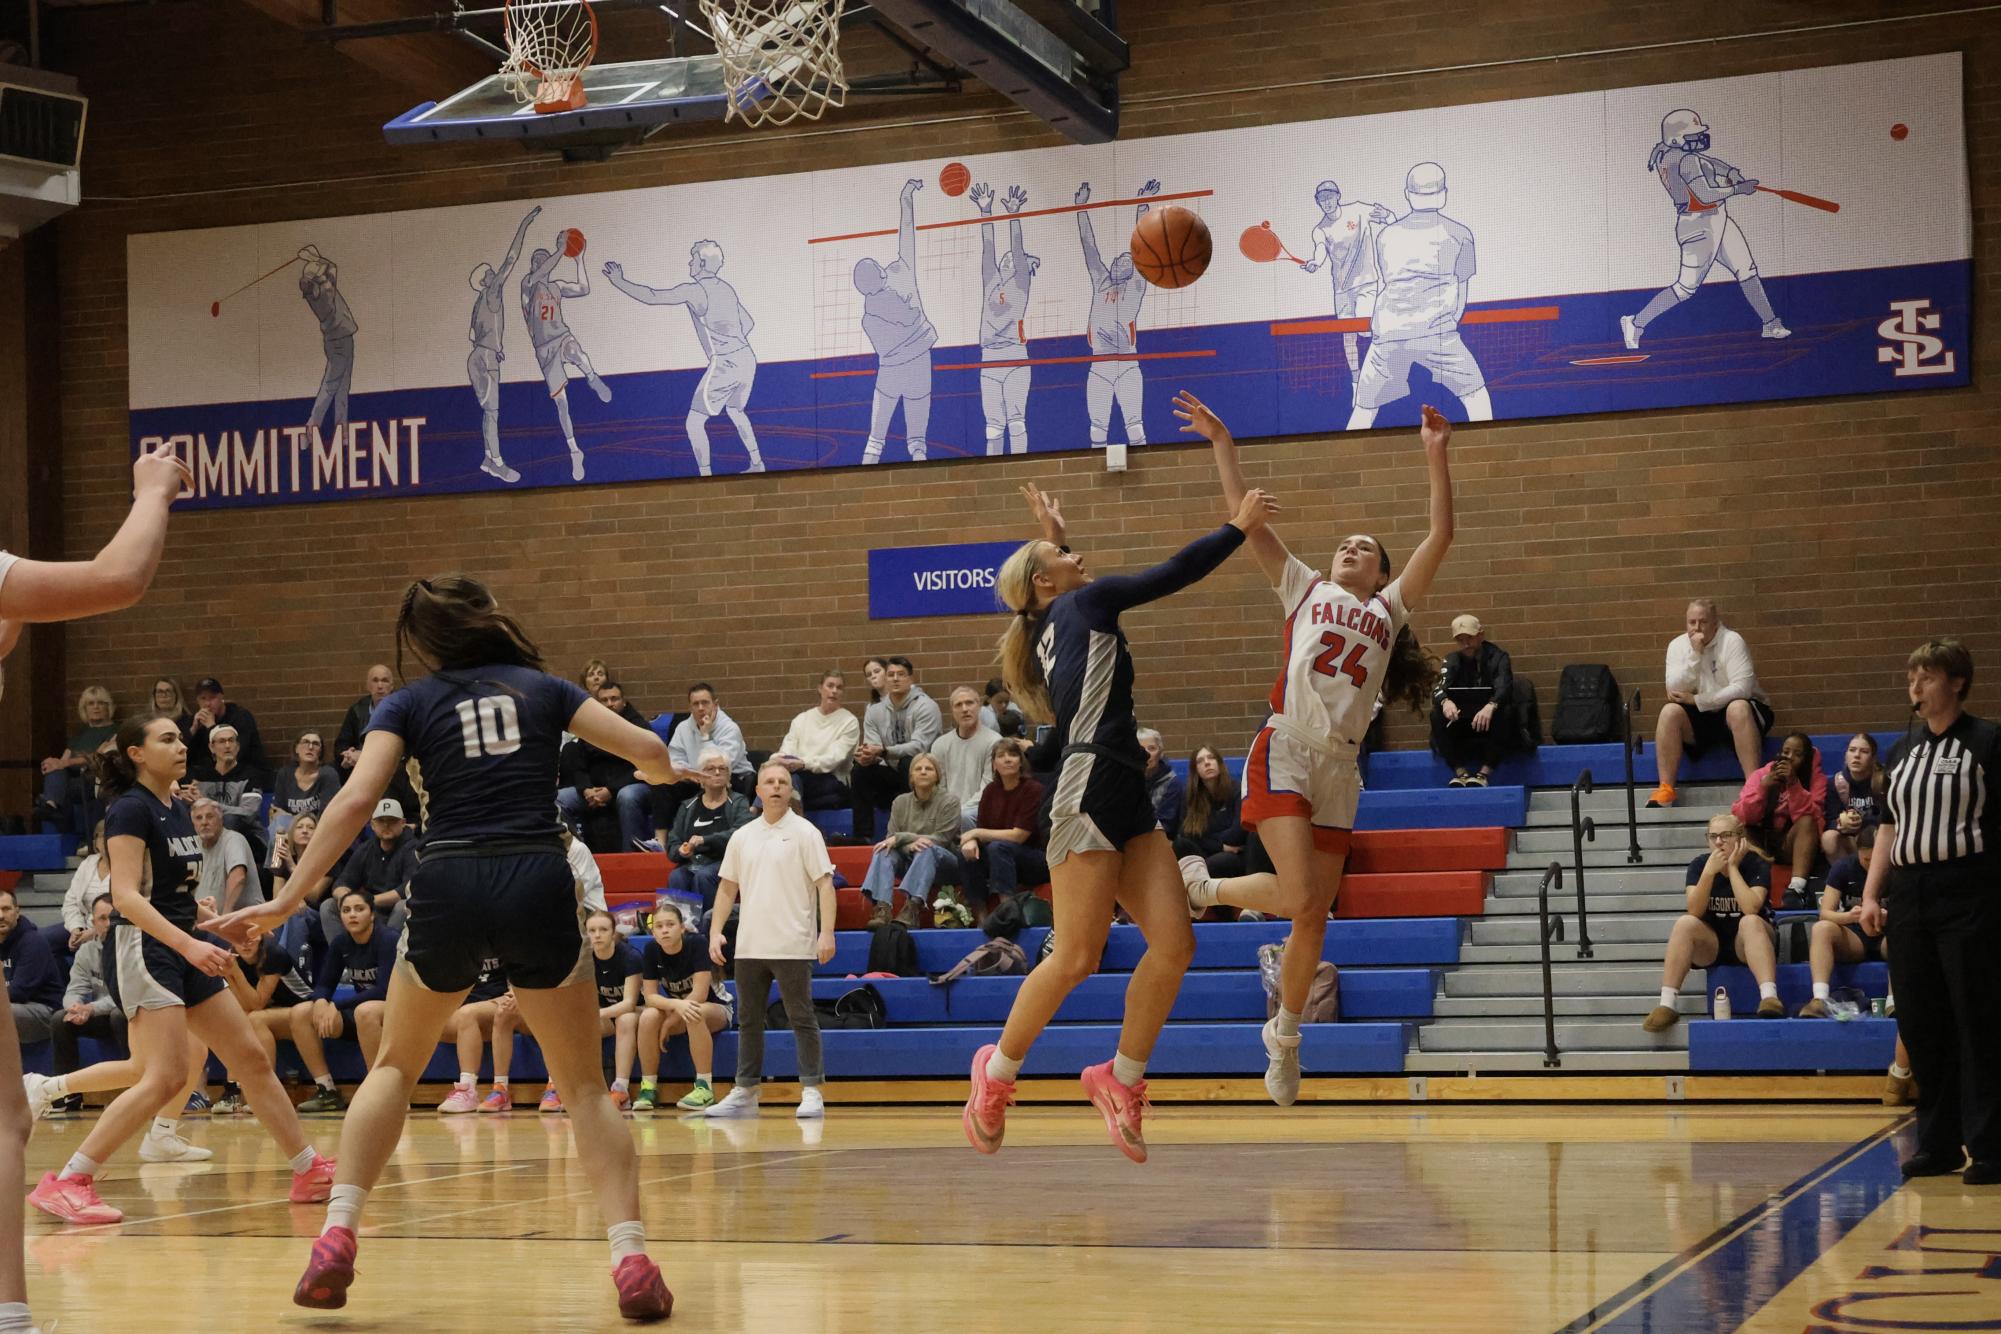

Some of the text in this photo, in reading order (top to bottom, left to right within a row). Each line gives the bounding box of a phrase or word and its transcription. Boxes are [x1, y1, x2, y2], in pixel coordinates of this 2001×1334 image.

[541, 305, 554, 321] 21
[913, 567, 995, 591] VISITORS
[1311, 602, 1390, 651] FALCONS
[1312, 630, 1369, 689] 24
[455, 694, 521, 759] 10
[383, 802, 391, 812] P
